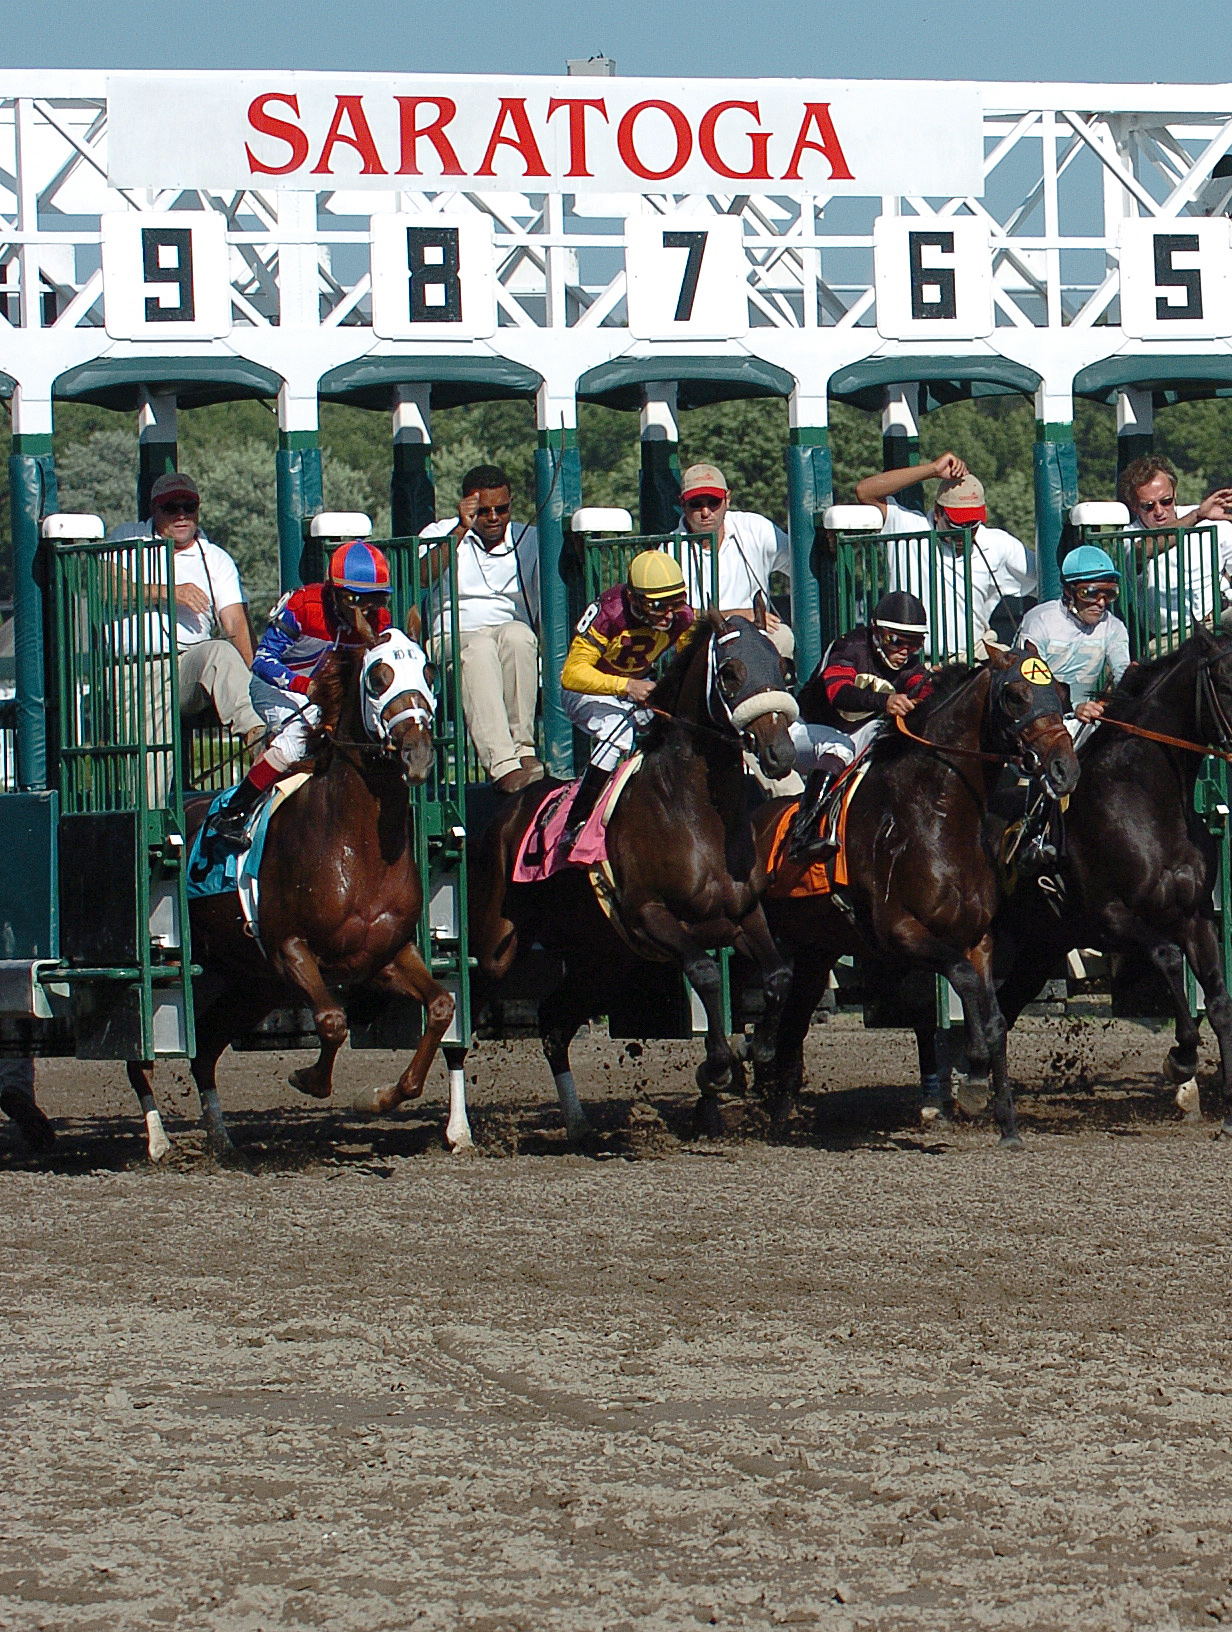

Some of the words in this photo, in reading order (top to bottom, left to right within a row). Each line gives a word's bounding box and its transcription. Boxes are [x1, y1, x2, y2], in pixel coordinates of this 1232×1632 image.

[246, 92, 854, 181] SARATOGA
[141, 228, 195, 322] 9
[407, 227, 462, 322] 8
[662, 231, 709, 322] 7
[908, 231, 956, 320] 6
[1153, 233, 1204, 320] 5
[576, 602, 599, 634] 8
[609, 634, 656, 671] R
